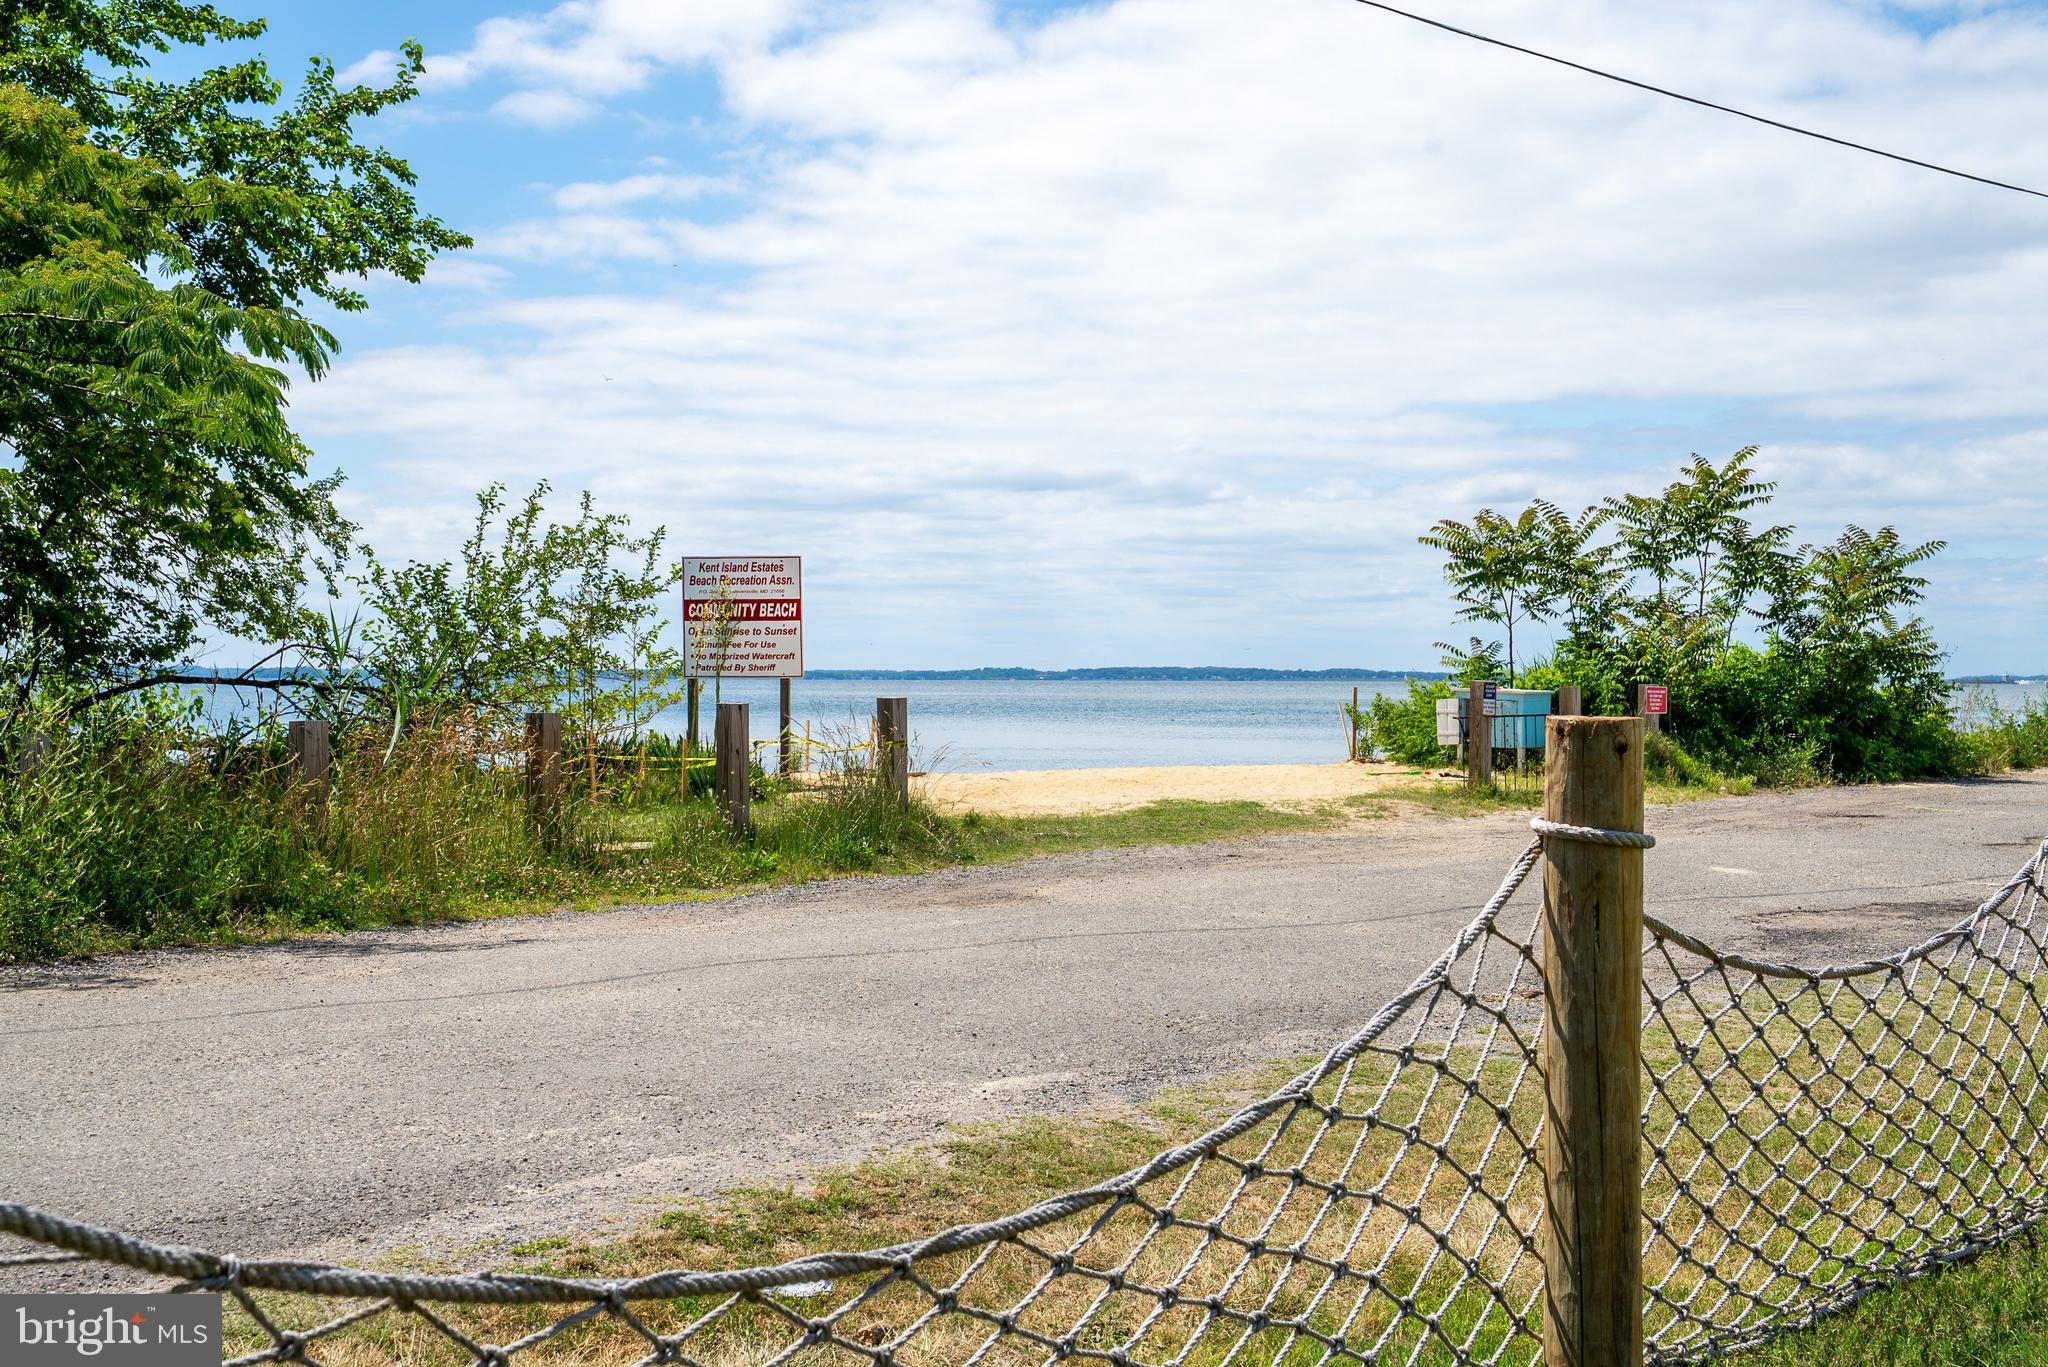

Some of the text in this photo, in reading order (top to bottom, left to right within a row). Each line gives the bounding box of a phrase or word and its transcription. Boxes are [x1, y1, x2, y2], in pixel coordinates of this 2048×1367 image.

[699, 562, 784, 572] Kent Island Estates
[689, 575, 795, 586] Beach Recreation Assn.
[760, 603, 797, 617] BEACH
[714, 627, 750, 636] Sunrise
[752, 627, 762, 635] to
[764, 626, 797, 635] Sunset
[734, 664, 746, 672] By
